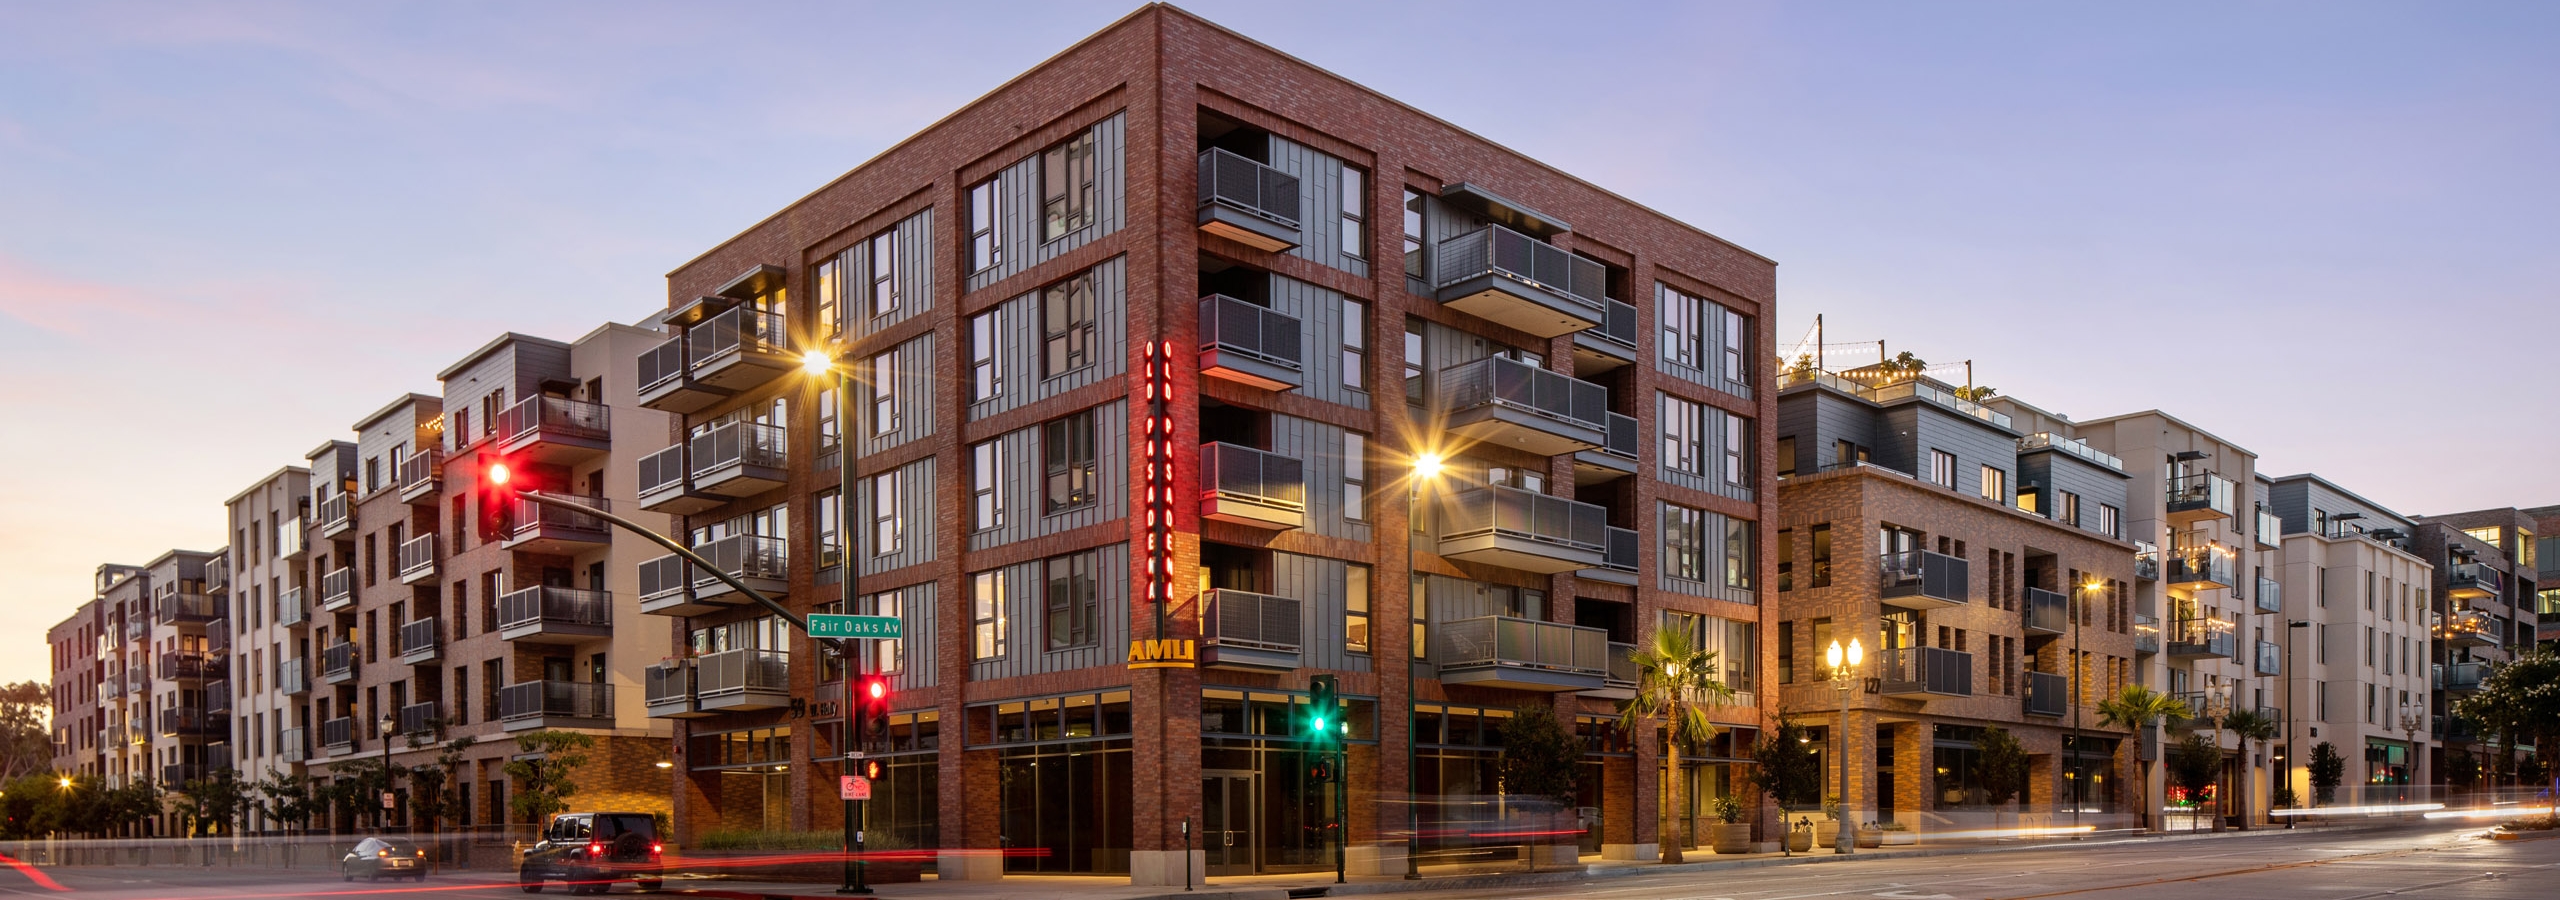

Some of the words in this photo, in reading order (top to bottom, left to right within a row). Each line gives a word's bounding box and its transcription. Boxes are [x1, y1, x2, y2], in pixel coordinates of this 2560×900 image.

[1147, 417, 1155, 599] PASADENA
[1165, 417, 1174, 600] PASADENA
[811, 619, 838, 632] Fair
[845, 620, 879, 633] Oaks
[884, 621, 899, 634] Av
[1864, 677, 1880, 694] 127
[790, 698, 806, 719] 59
[820, 701, 838, 717] Holly
